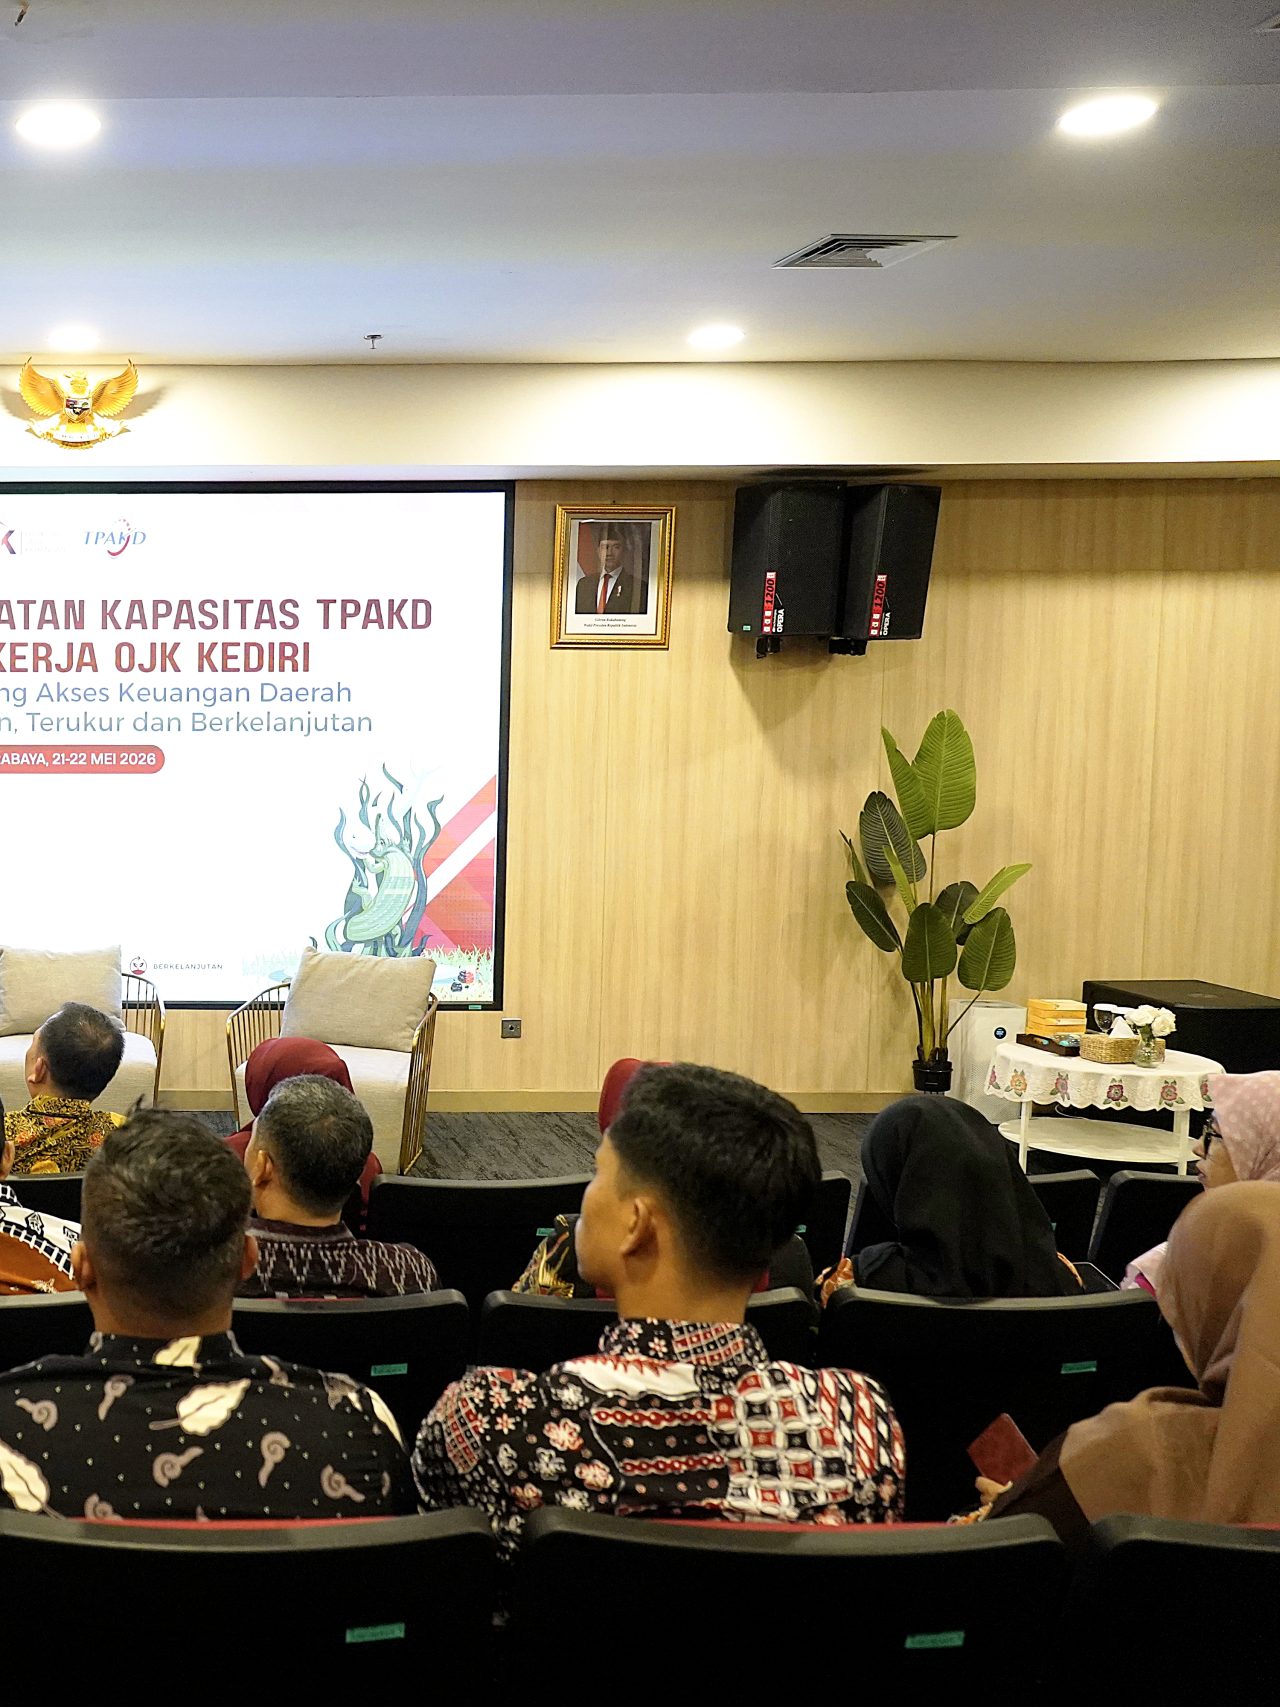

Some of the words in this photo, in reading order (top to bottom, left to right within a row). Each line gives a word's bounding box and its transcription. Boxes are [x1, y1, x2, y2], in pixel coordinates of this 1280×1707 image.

[101, 598, 300, 631] KAPASITAS
[316, 599, 432, 630] TPAKD
[114, 642, 182, 673] OJK
[197, 642, 310, 673] KEDIRI
[35, 682, 110, 702] Akses
[119, 682, 250, 707] Keuangan
[260, 682, 352, 702] Daerah
[26, 712, 125, 732] Terukur
[132, 711, 182, 732] dan
[191, 711, 373, 737] Berkelanjutan
[52, 752, 87, 765] 21-22
[90, 752, 117, 765] MEI
[119, 752, 157, 765] 2026
